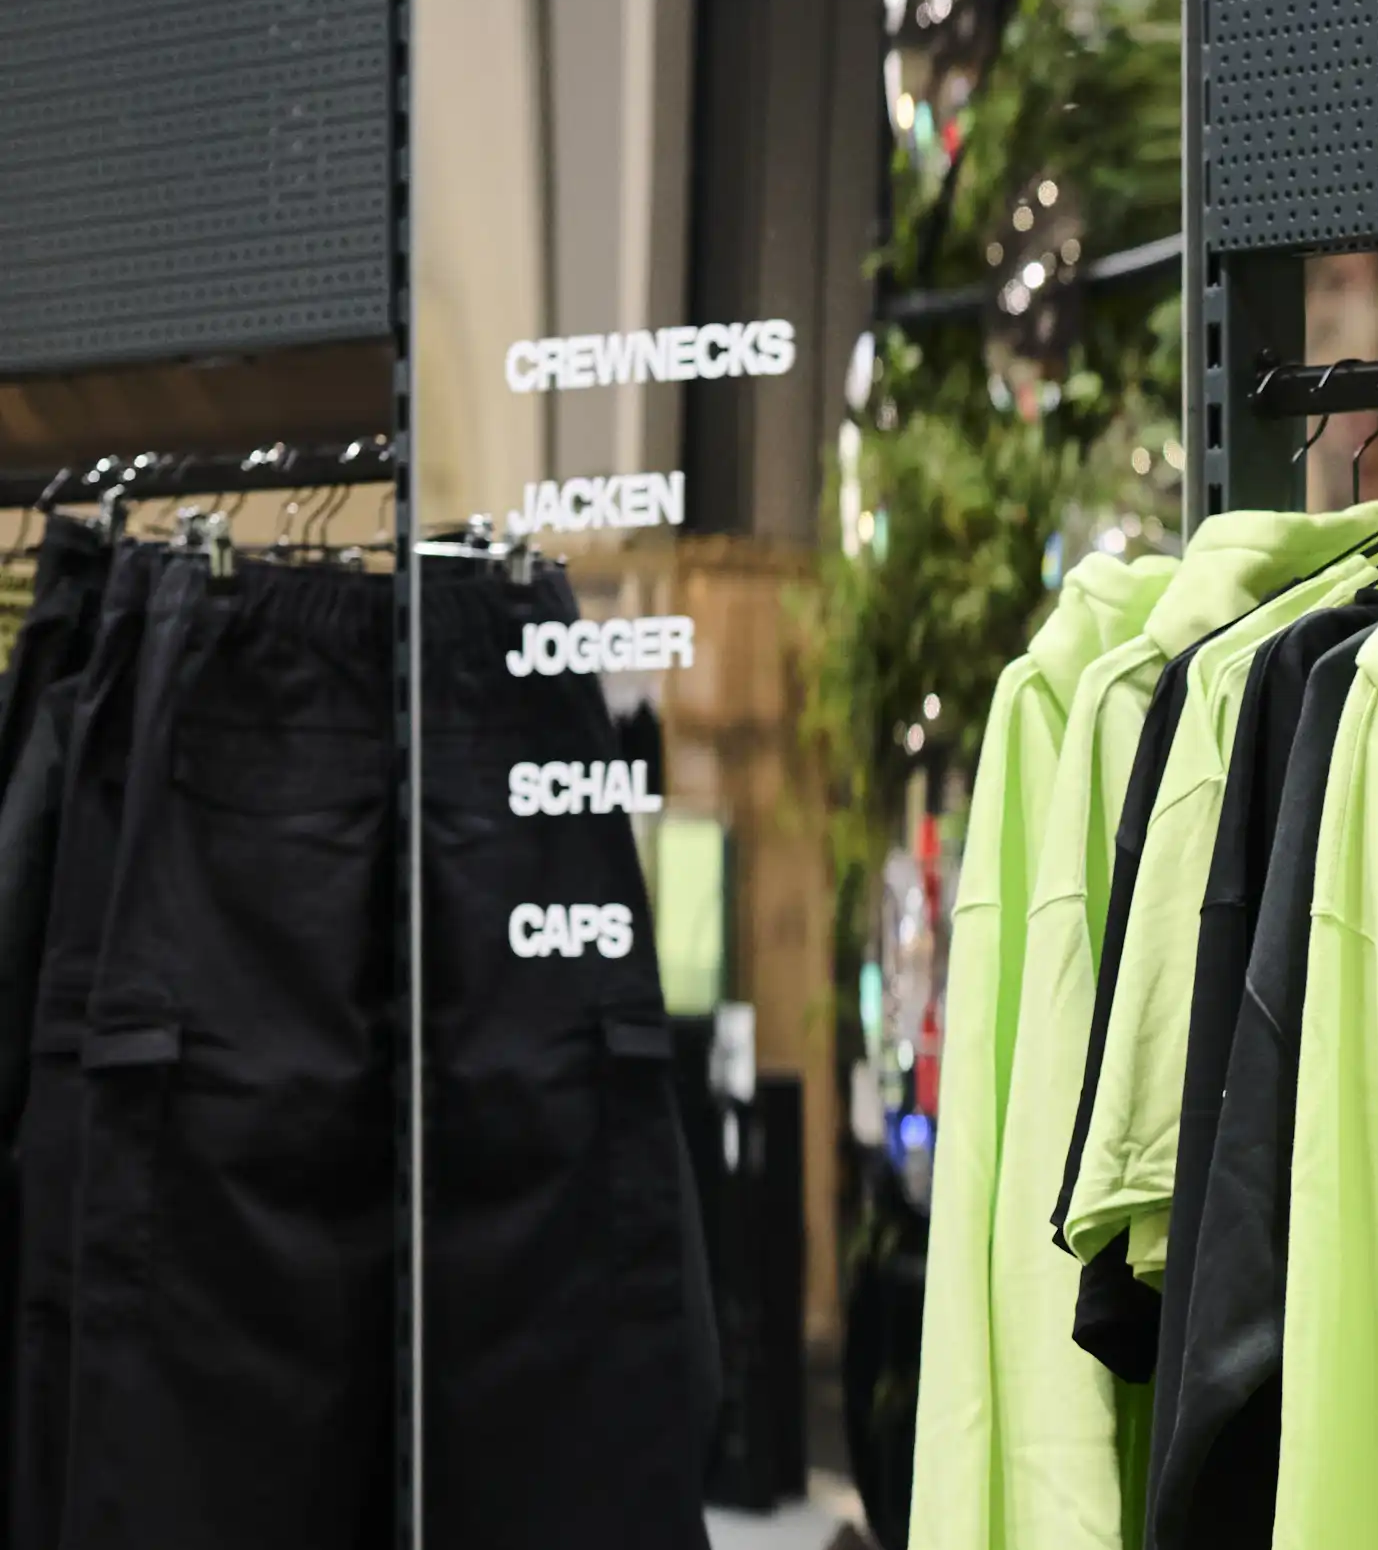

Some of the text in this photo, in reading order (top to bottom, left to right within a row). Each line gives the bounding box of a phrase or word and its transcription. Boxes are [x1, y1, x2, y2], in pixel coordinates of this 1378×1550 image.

[504, 319, 795, 393] CREWNECKS
[507, 471, 686, 536] JACKEN
[506, 616, 695, 676] JOGGER
[509, 760, 662, 816] SCHAL
[509, 903, 633, 958] CAPS
